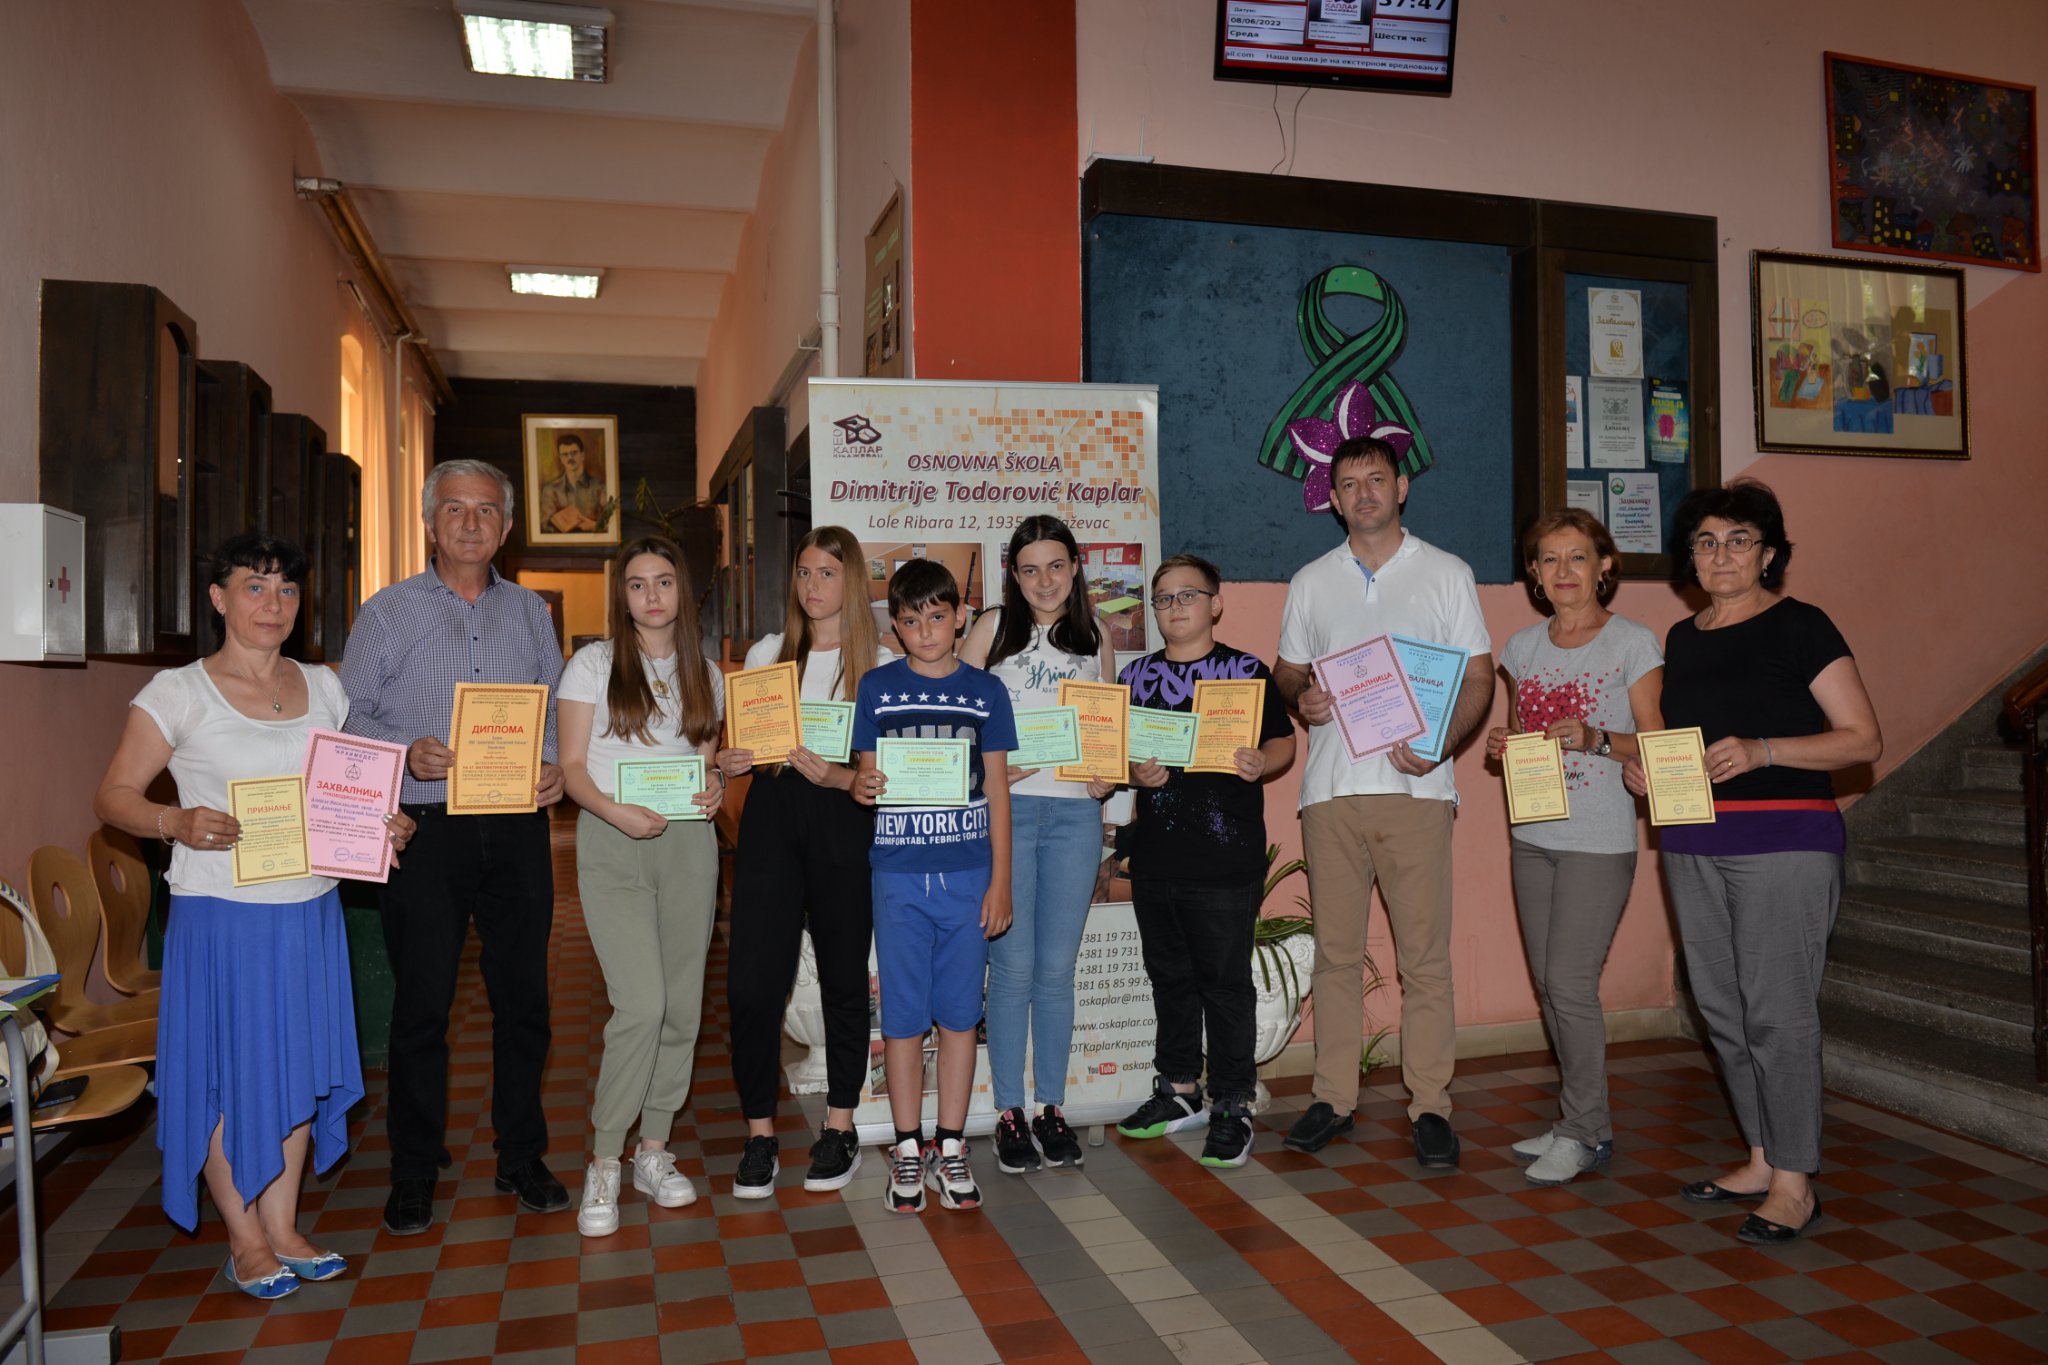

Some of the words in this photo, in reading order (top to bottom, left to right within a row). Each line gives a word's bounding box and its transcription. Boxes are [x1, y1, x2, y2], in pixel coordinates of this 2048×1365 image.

[1230, 17, 1281, 26] 08/06/2022
[1388, 62, 1439, 72] вредновању
[833, 446, 883, 454] КАПЛАР
[907, 454, 999, 471] OSNOVNA
[1004, 450, 1062, 471] ŠKOLA
[829, 479, 938, 505] Dimitrije
[945, 480, 1061, 502] Todorović
[1066, 481, 1143, 506] Kaplar
[869, 515, 900, 529] Lole
[904, 515, 953, 529] Ribara
[959, 516, 981, 532] 12,
[1339, 672, 1393, 697] ЗАХВАЛНИЦА
[1407, 673, 1444, 688] ВАЛНИЦА
[742, 694, 783, 708] ДИПЛОМА
[1079, 714, 1114, 724] ИПЛОМА
[1206, 709, 1246, 717] ДИПЛОМА
[472, 725, 524, 735] ДИПЛОМА
[1515, 755, 1551, 765] ПРИЗНАЊЕ
[1655, 754, 1694, 764] ПРИЗНАЊЕ
[316, 780, 383, 799] ЗАХВАЛНИЦА
[247, 803, 293, 815] ПРИЗНАЊЕ
[876, 814, 908, 835] NEW
[910, 811, 959, 835] YORK
[962, 806, 988, 831] CITY
[875, 836, 927, 846] COMFORTABL
[929, 834, 961, 844] FEBRIC
[962, 832, 977, 841] FOR
[1105, 932, 1118, 942] 19
[1120, 931, 1138, 941] 731
[1078, 949, 1102, 959] +381
[1106, 947, 1118, 957] 19
[1121, 946, 1139, 956] 731
[1079, 965, 1103, 975] +381
[1107, 963, 1119, 973] 19
[1122, 962, 1139, 972] 731
[1098, 979, 1110, 989] 65
[1113, 978, 1126, 988] 85
[1128, 977, 1141, 987] 99
[1079, 993, 1153, 1008] oskaplar@mts.
[1122, 1059, 1156, 1073] oskapl
